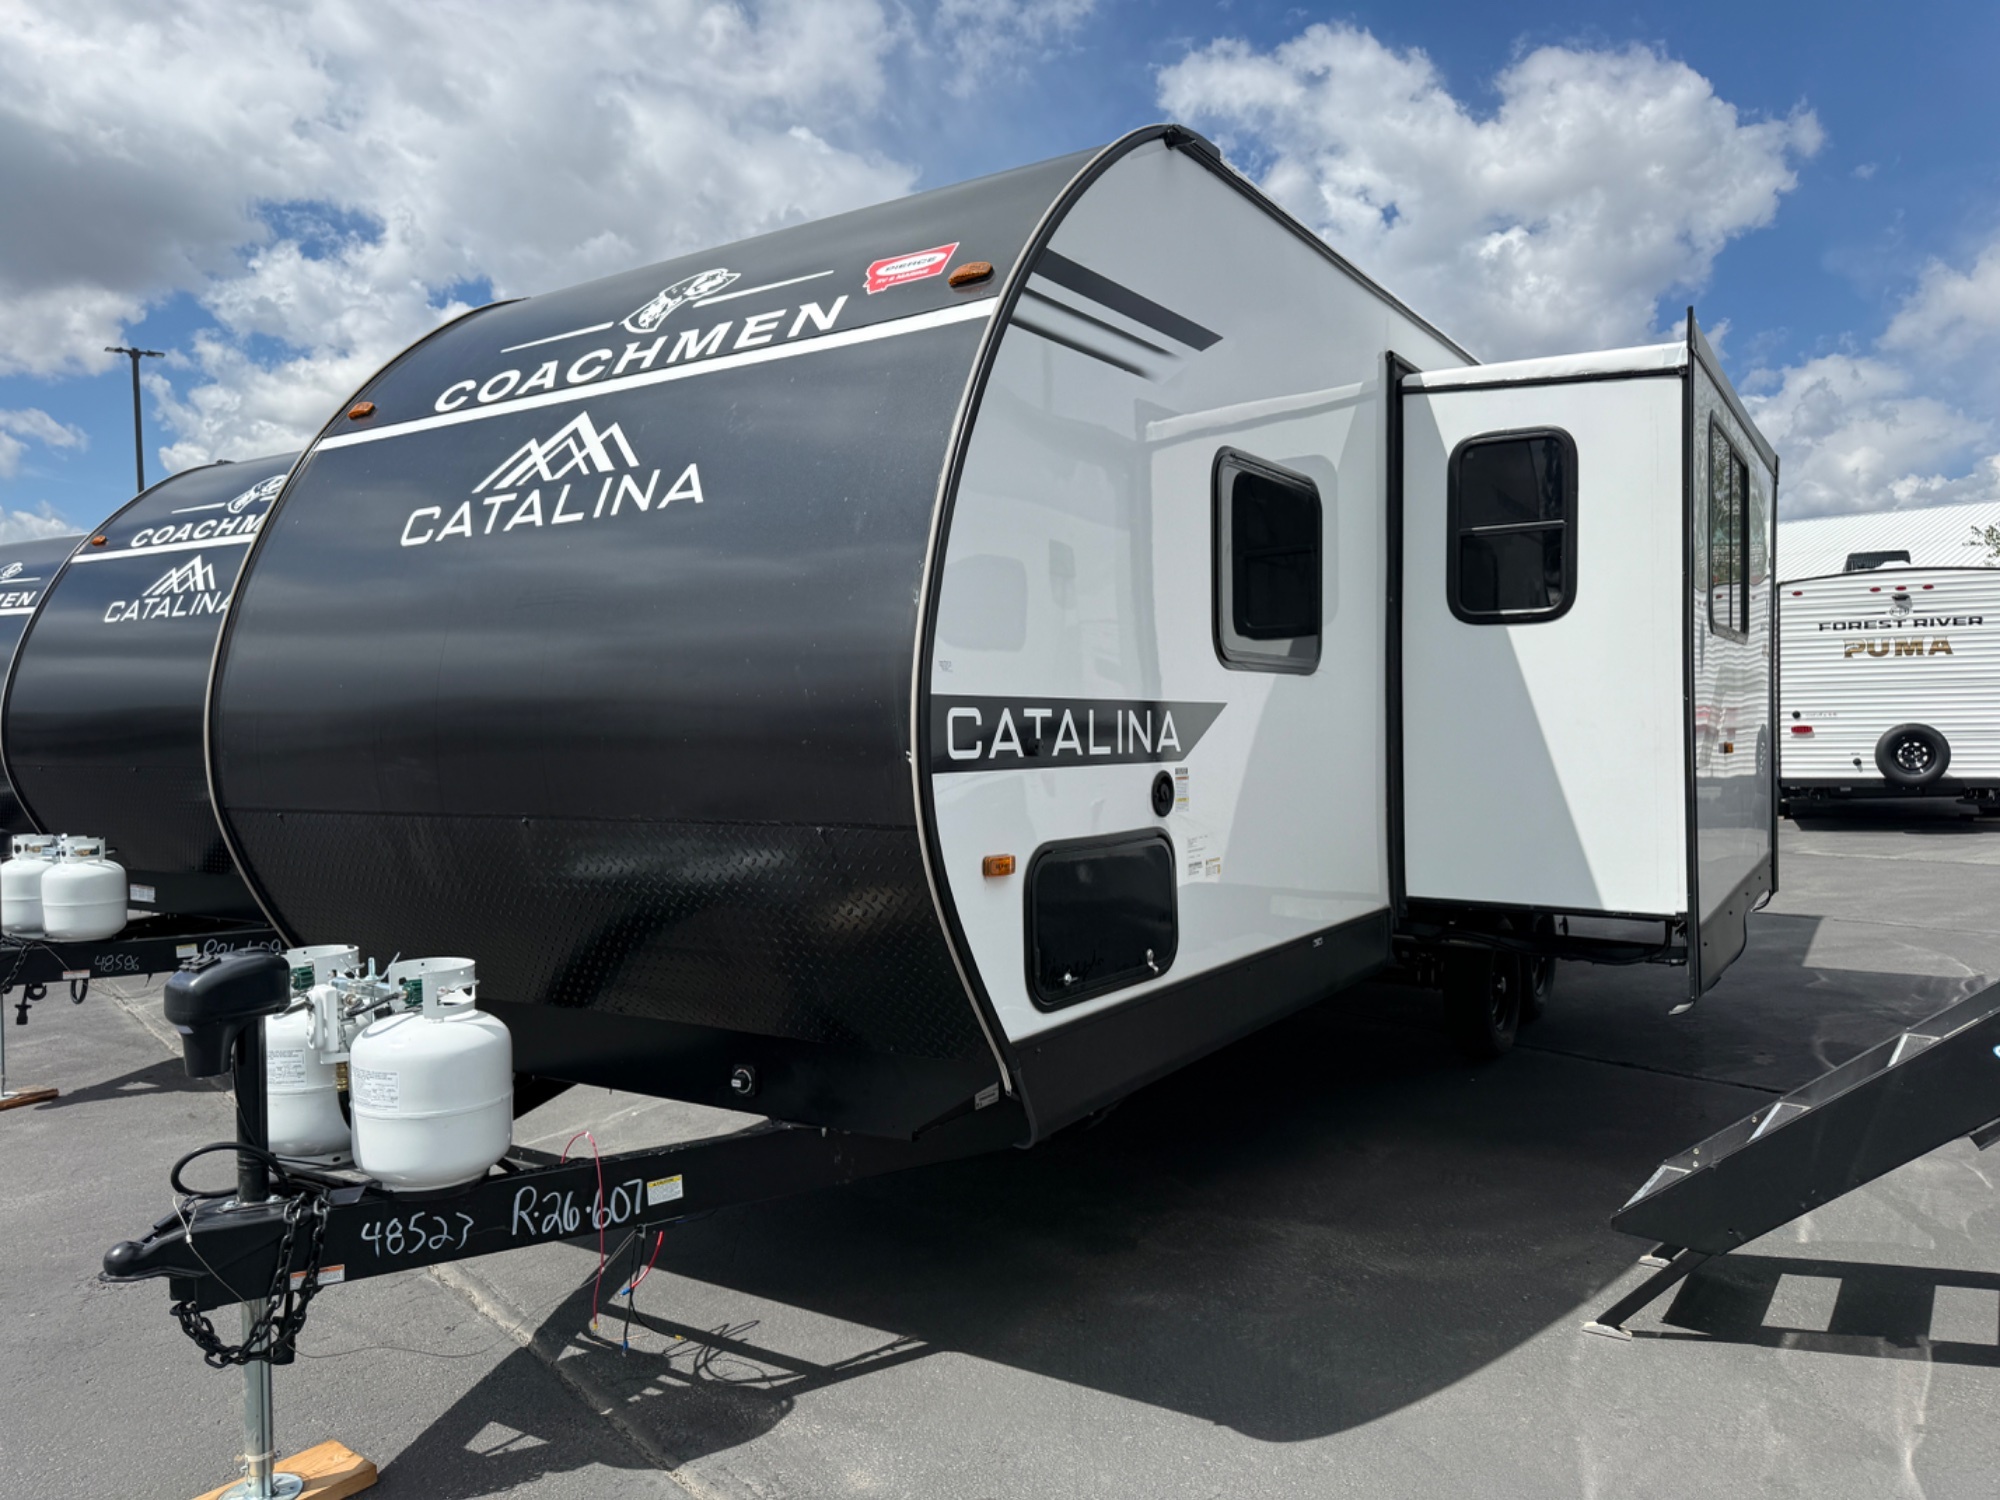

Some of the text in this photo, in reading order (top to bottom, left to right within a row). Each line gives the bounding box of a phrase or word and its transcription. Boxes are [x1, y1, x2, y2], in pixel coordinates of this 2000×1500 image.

[434, 295, 850, 413] COACHMEN
[401, 463, 704, 547] CATALINA
[1818, 616, 1983, 631] FOREST RIVER
[1843, 636, 1954, 659] PUMA
[947, 707, 1182, 760] CATALINA
[360, 1211, 474, 1258] 48523
